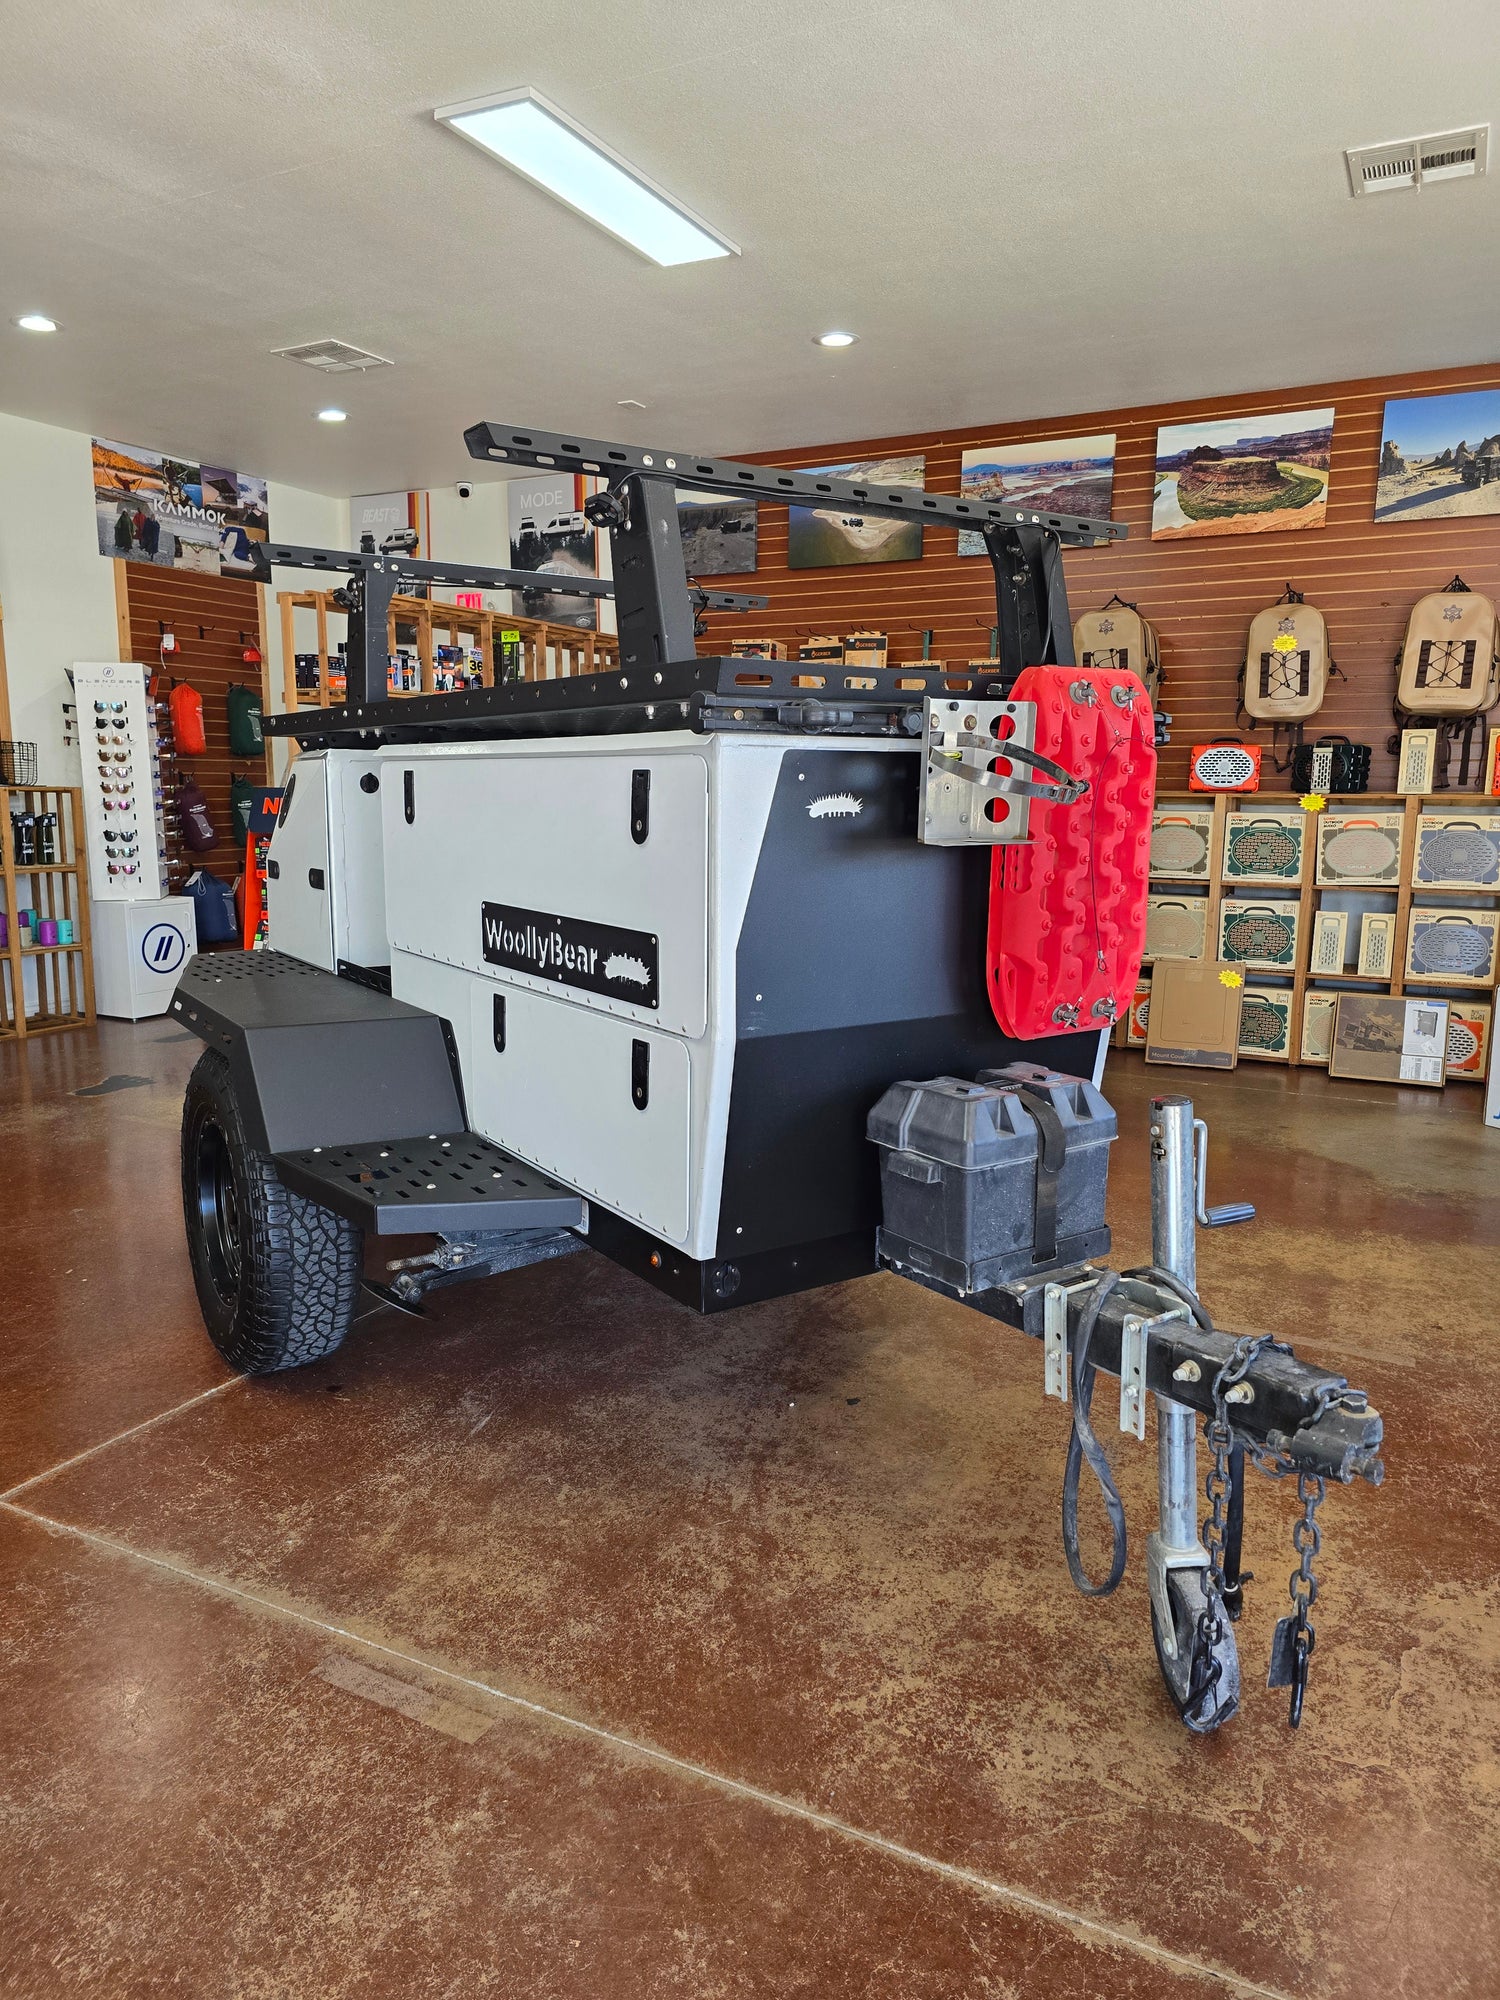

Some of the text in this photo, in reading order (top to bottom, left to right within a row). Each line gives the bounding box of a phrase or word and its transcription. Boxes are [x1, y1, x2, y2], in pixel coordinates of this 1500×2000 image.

[520, 490, 563, 510] MODE
[153, 499, 226, 526] KAMMOK
[362, 507, 390, 524] BEAST
[456, 592, 483, 610] EXIT
[485, 917, 598, 975] WoollyBear
